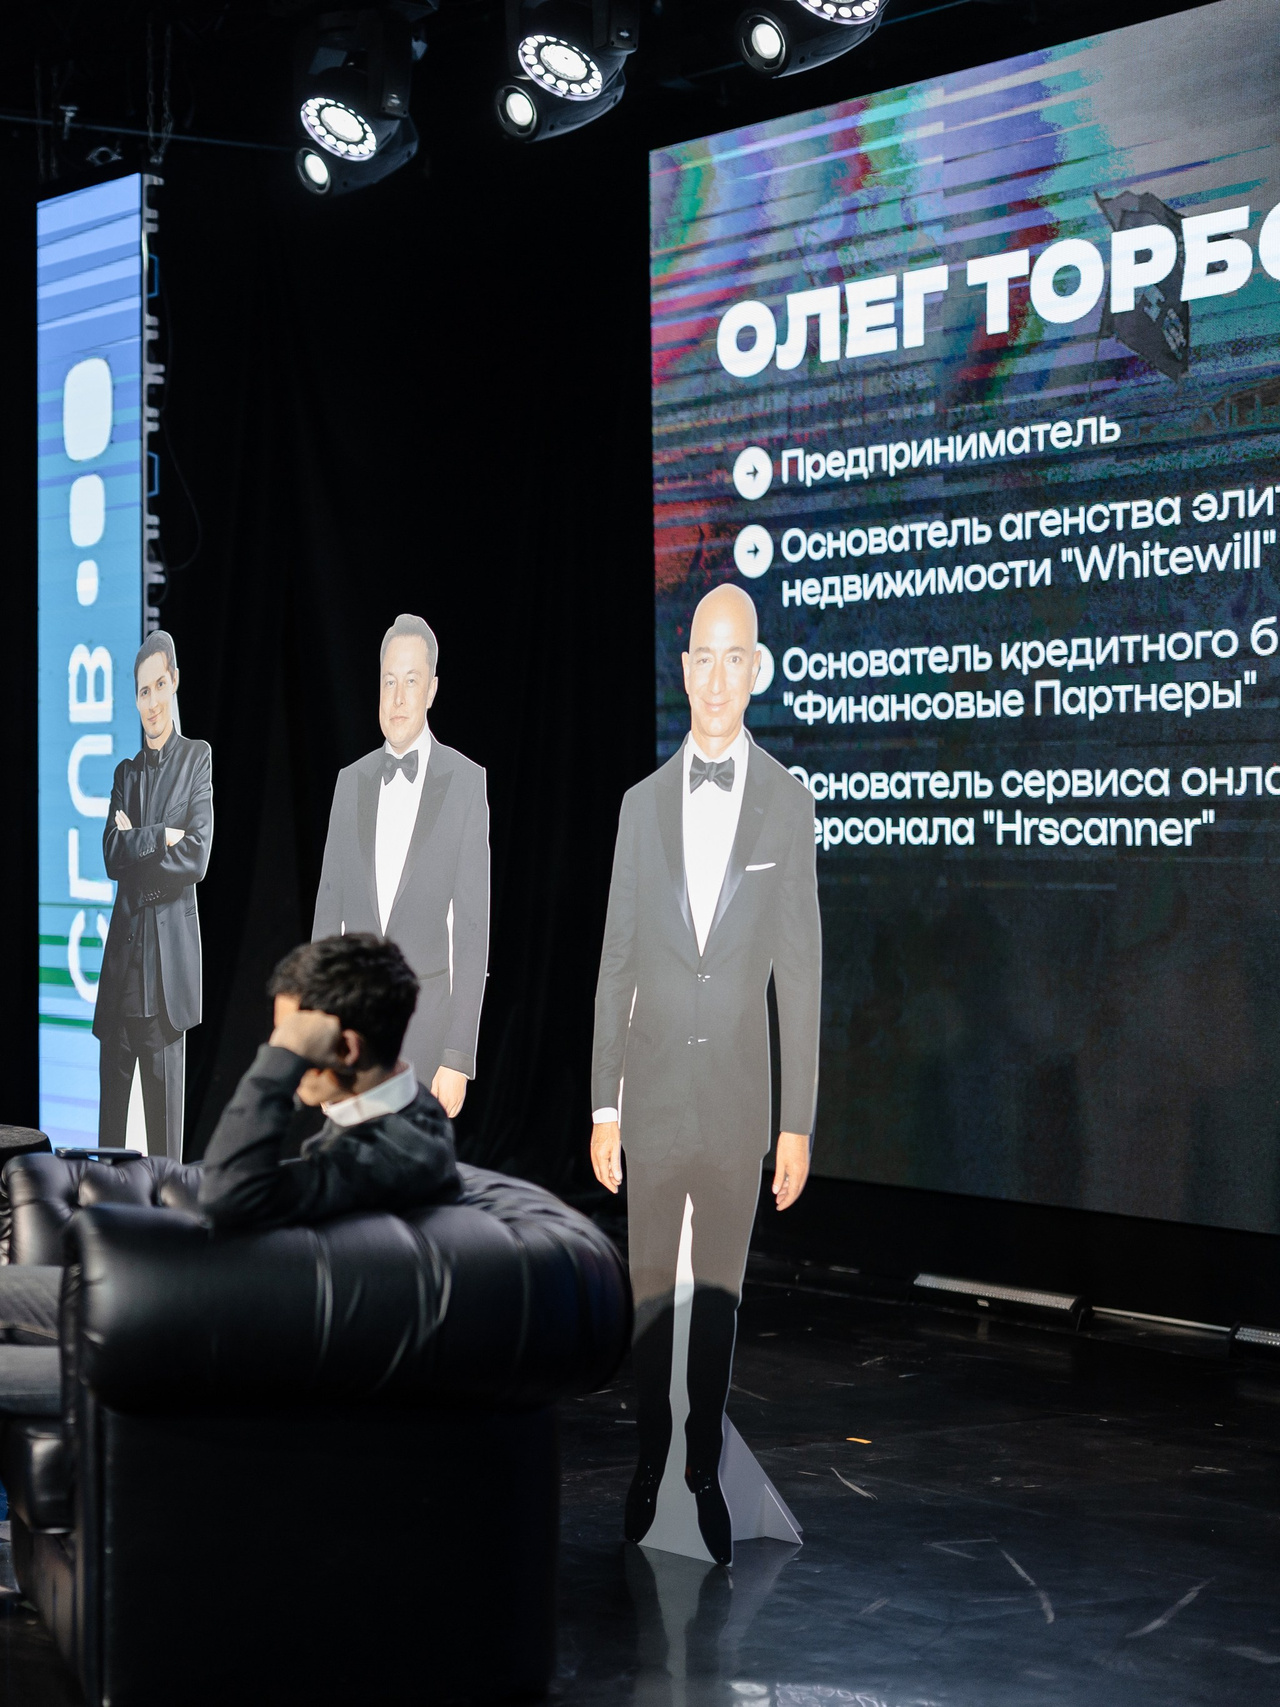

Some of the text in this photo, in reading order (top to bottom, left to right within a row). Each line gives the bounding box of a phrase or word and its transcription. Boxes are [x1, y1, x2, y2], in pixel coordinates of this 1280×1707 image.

[716, 264, 949, 378] ОЛЕГ
[781, 415, 1121, 487] Предприниматель
[781, 485, 1280, 563] Основатель агенства эли
[782, 529, 1276, 610] недвижимости "Whitewill"
[782, 644, 993, 682] Основатель
[1001, 628, 1239, 676] кредитного
[783, 669, 1257, 726] "Финансовые Партнеры"
[1000, 767, 1170, 804] сервиса
[814, 809, 1215, 851] рсонала "Hrscanner"
